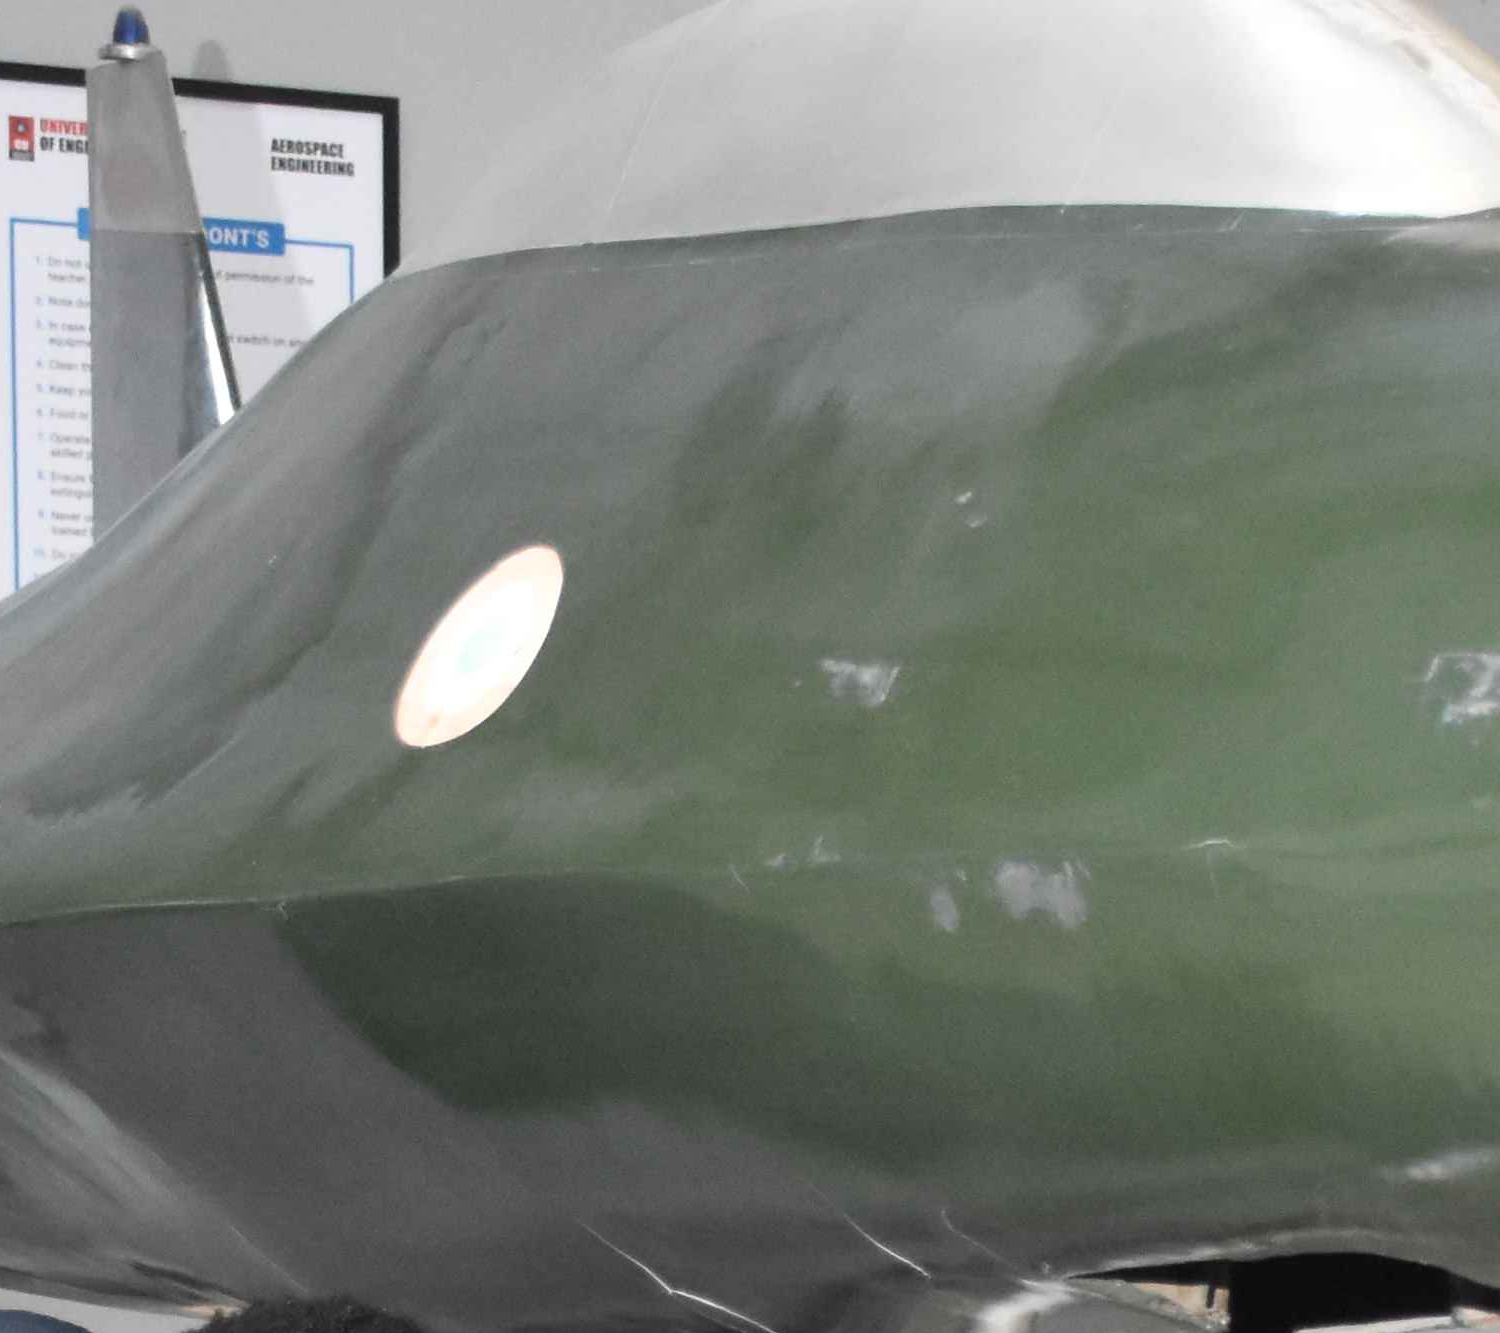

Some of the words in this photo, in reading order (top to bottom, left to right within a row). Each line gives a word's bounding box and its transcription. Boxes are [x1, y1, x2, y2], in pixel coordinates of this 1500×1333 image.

[40, 118, 88, 136] UNIVER
[40, 136, 55, 151] OF
[271, 138, 345, 159] AEROSPACE
[271, 157, 355, 177] ENGINEERING
[209, 226, 270, 249] ONT'S
